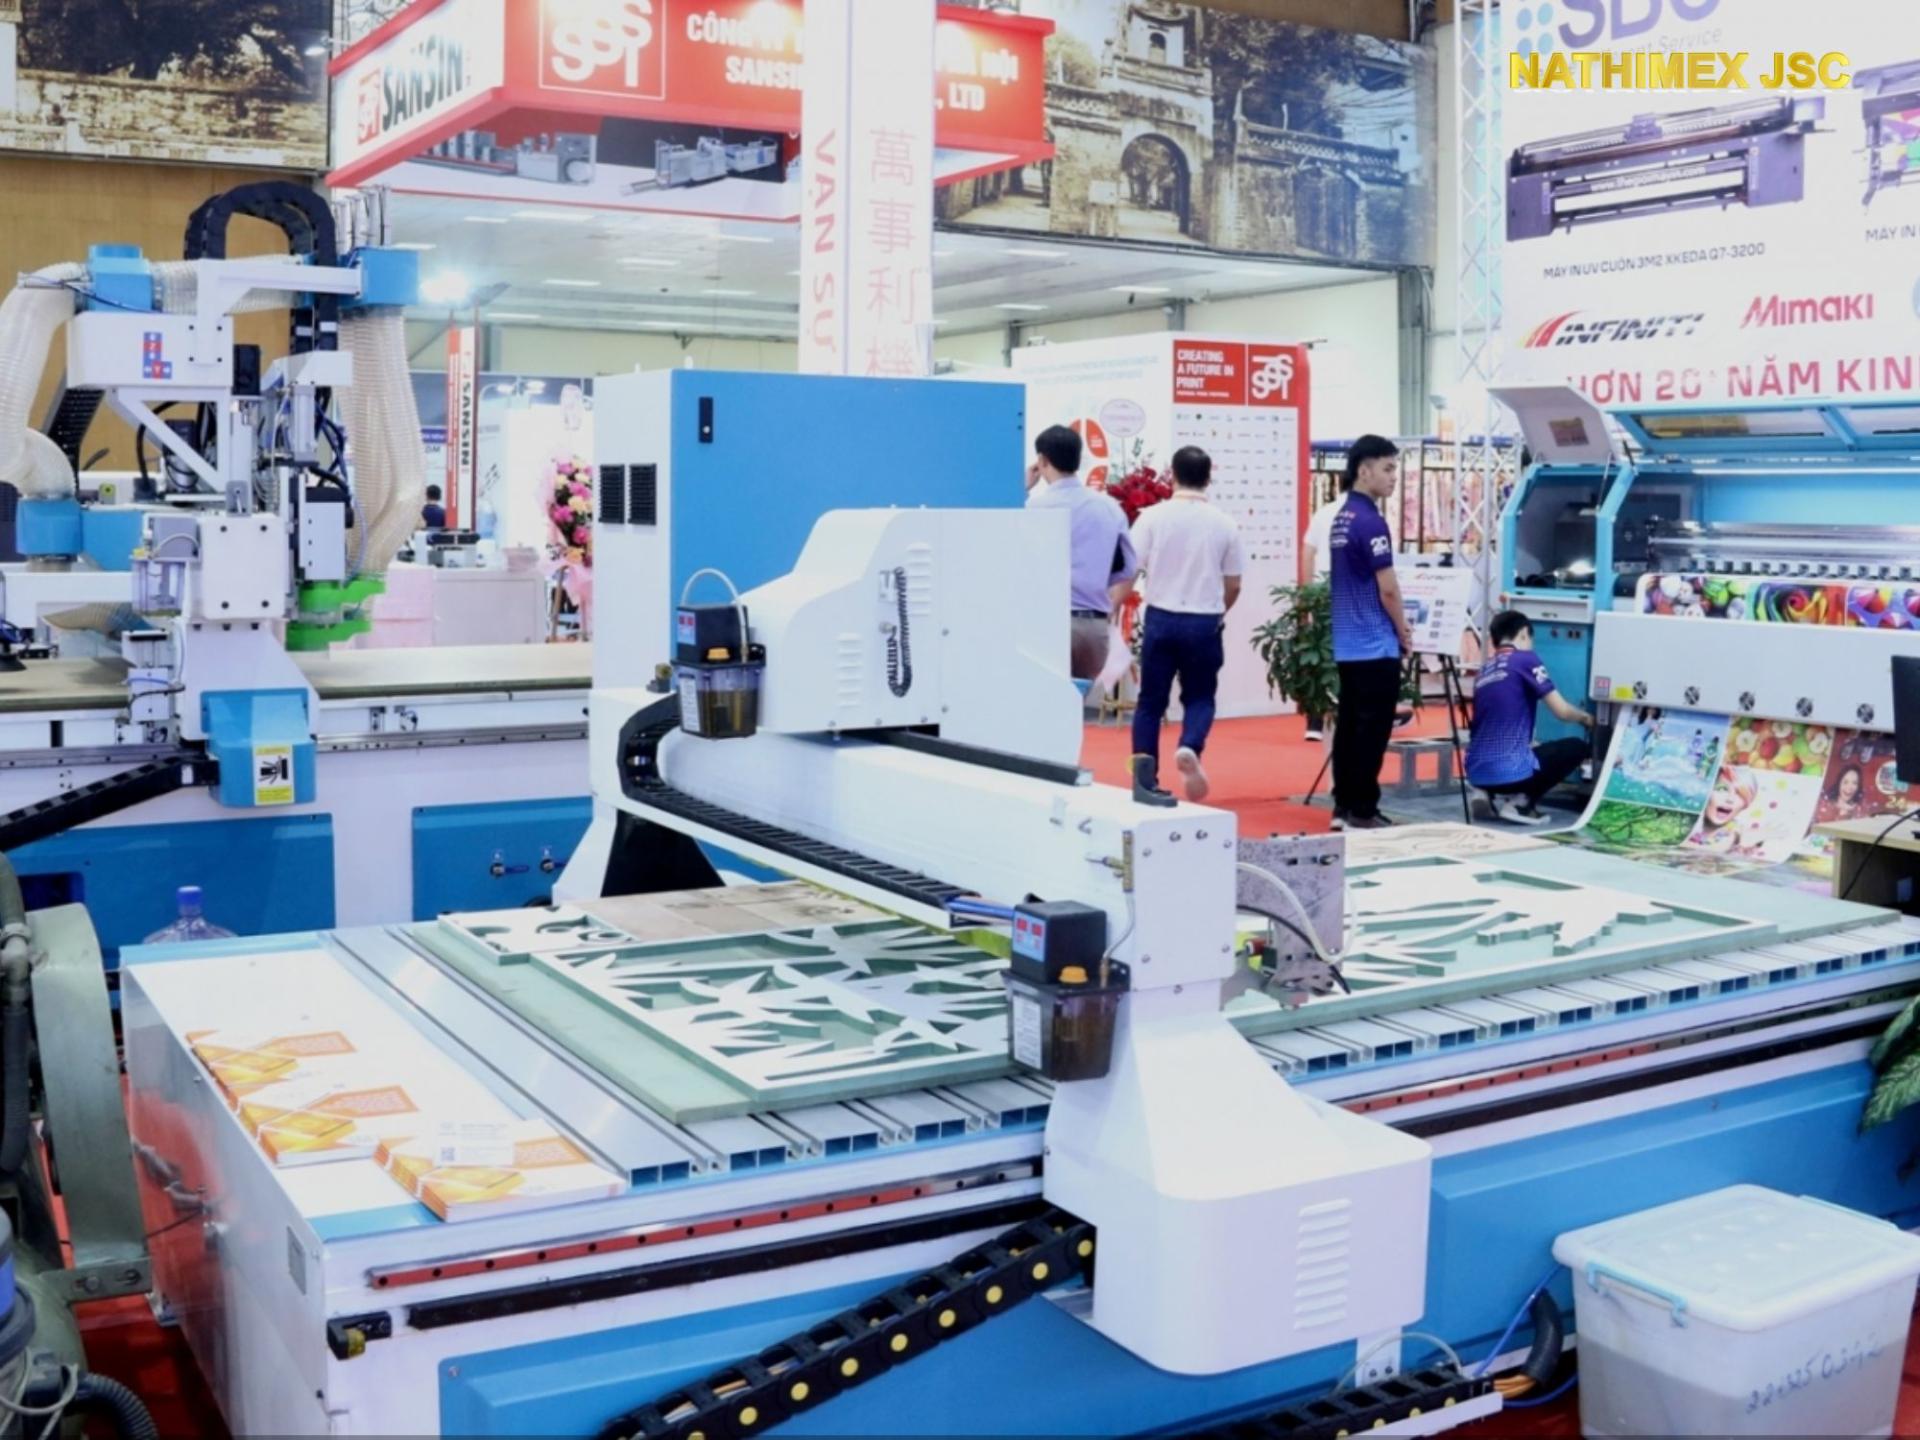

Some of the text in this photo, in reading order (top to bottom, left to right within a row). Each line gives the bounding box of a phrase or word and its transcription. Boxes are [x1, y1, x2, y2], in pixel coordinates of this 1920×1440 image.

[726, 55, 803, 91] SANSI
[949, 82, 985, 110] LTD
[1177, 362, 1185, 375] A
[1727, 355, 1821, 399] NĂM
[1837, 355, 1920, 393] KIN
